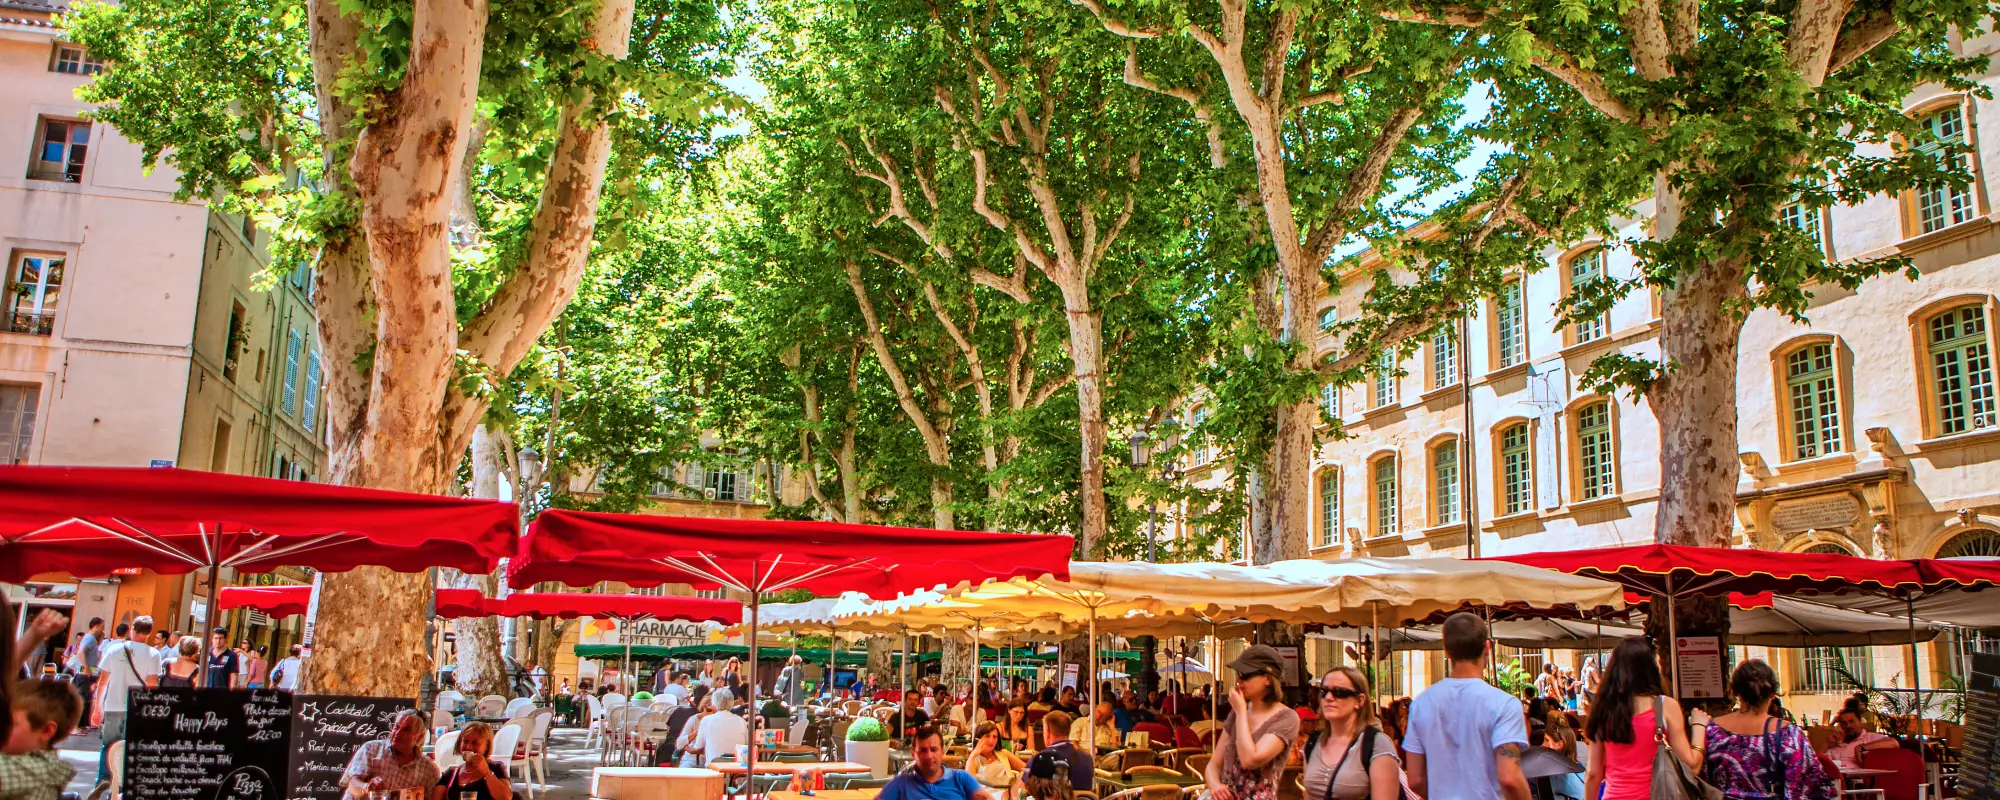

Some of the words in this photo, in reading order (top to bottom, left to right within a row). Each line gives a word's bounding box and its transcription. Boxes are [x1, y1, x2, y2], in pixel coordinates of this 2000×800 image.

[126, 597, 145, 605] THE
[620, 621, 706, 638] PHARMACIE
[659, 638, 672, 646] DE
[325, 700, 375, 718] Cocktail
[175, 713, 203, 733] Happy
[203, 711, 228, 731] Days
[308, 740, 325, 753] Red
[233, 773, 263, 794] Pizza
